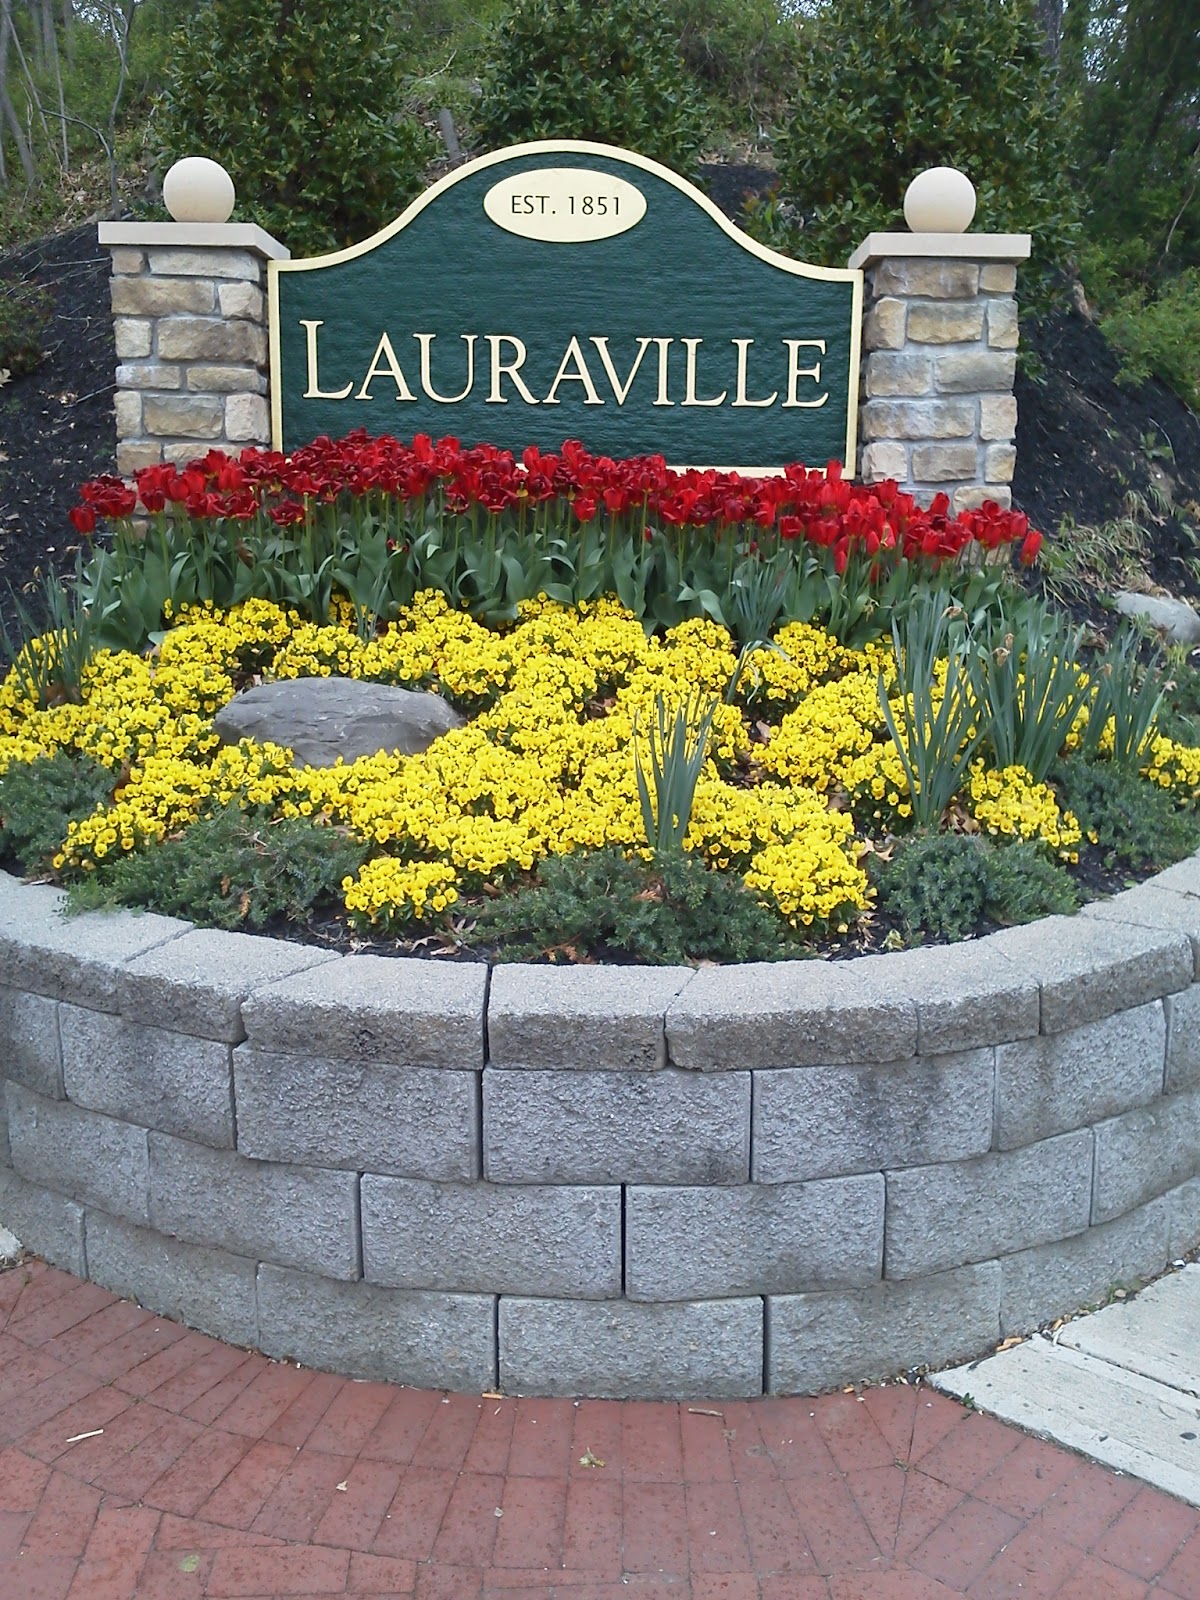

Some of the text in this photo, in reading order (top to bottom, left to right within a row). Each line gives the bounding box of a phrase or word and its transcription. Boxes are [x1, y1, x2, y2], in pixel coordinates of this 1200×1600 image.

[511, 195, 620, 216] EST. 1851
[299, 319, 829, 409] LAURAVILLE
